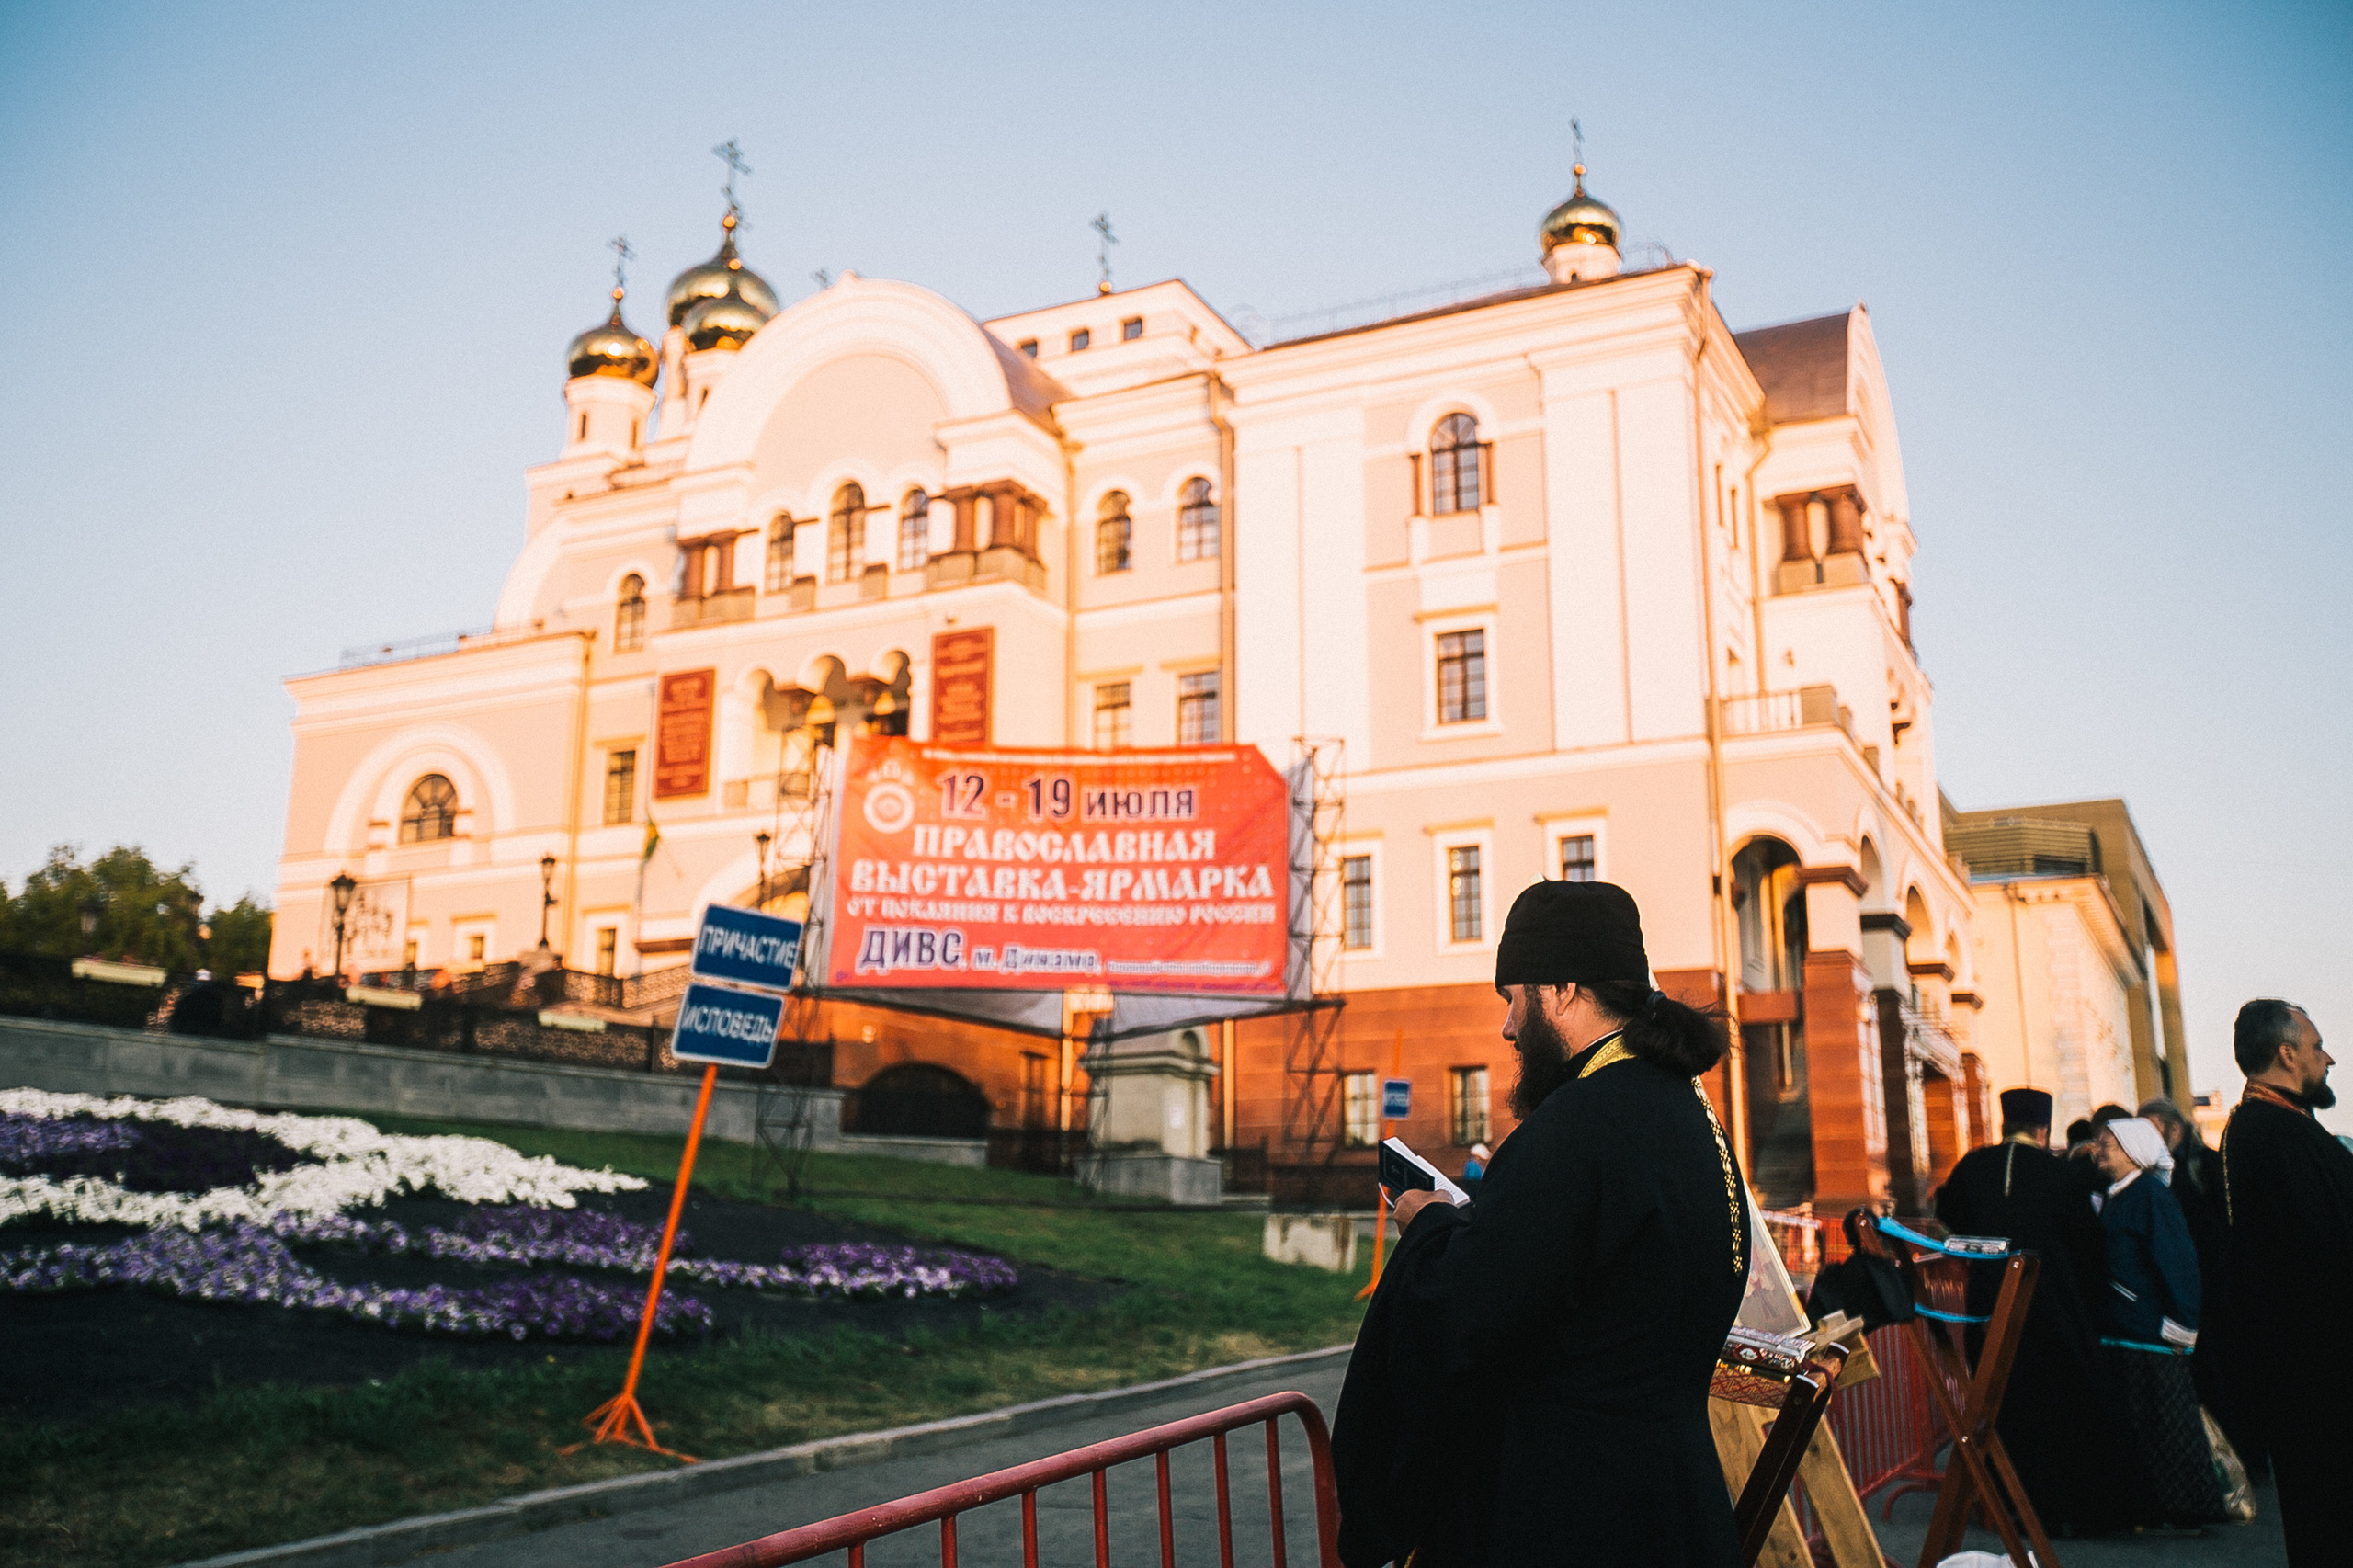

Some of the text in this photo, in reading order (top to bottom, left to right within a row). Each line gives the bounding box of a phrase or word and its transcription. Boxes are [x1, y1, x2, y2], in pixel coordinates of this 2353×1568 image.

[938, 772, 987, 816] 12
[1027, 776, 1073, 820] 19
[1084, 787, 1197, 820] июля
[913, 824, 1216, 863] ПРАВОСЛАВНАЯ
[850, 858, 1275, 902] ВЫСТАВКА-ЯРМАРКА
[699, 925, 797, 969] ПРИЧАСТИЕ
[681, 1004, 774, 1047] ИСПОВЕДЬ
